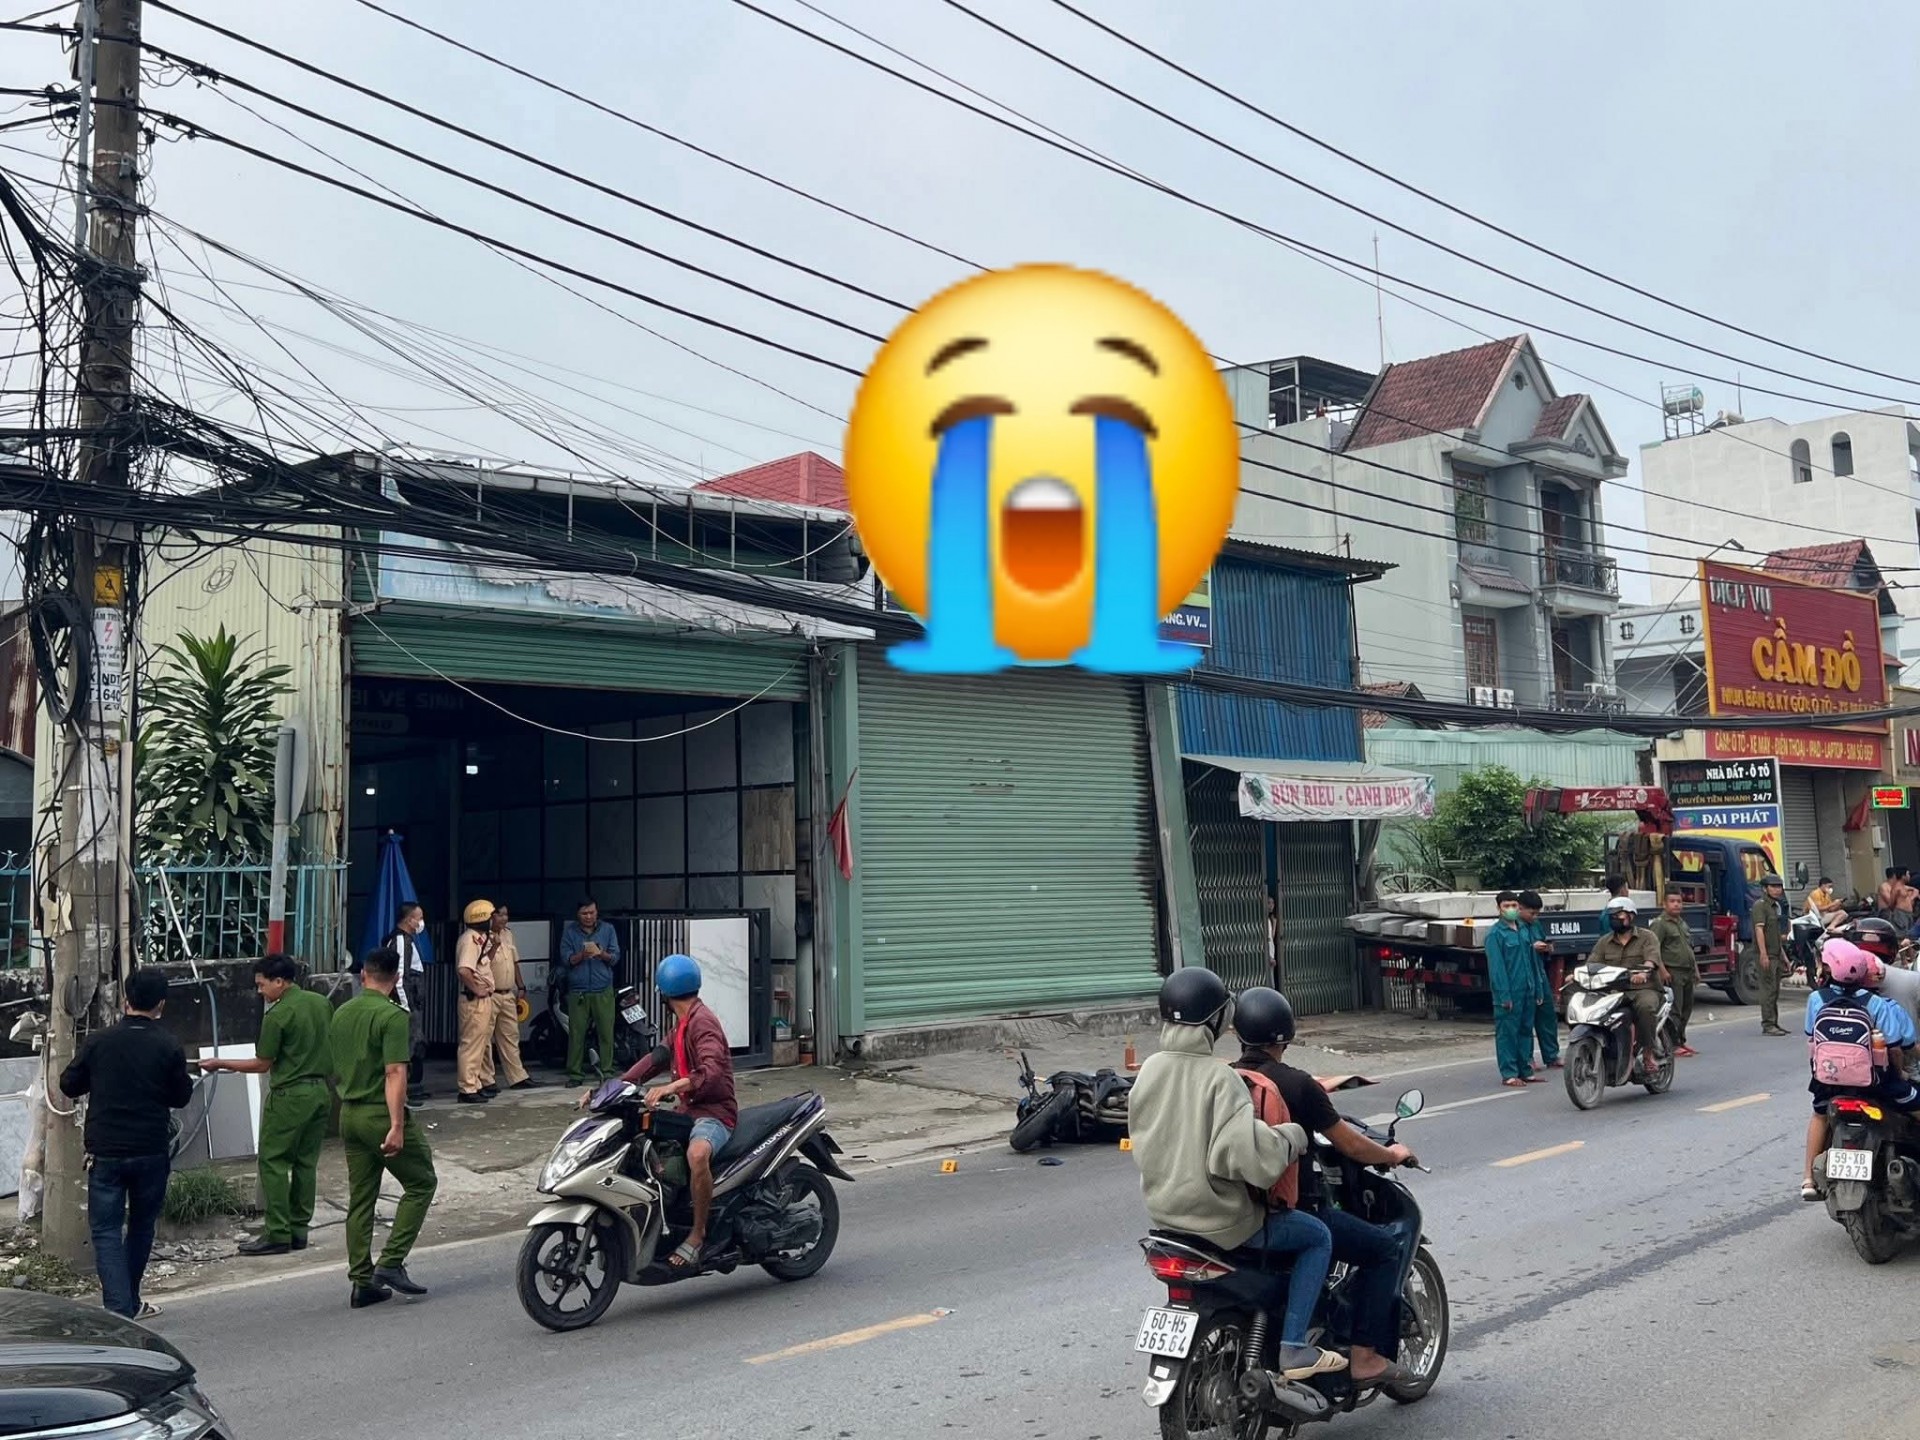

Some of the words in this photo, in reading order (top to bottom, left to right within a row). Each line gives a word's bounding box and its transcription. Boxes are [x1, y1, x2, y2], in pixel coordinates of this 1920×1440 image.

[1709, 576, 1746, 613] DỊCH
[1748, 584, 1771, 622] VỤ
[1752, 616, 1818, 687] CẦM
[1820, 629, 1861, 692] ĐỒ
[1706, 764, 1725, 780] NHÀ
[1726, 762, 1744, 779] ĐẤT
[1749, 763, 1757, 777] Ô
[1758, 762, 1770, 777] TÔ
[1346, 784, 1381, 806] CANH
[1753, 792, 1772, 801] 24/7
[1702, 813, 1727, 827] ĐẠI
[1731, 810, 1769, 824] PHÁT
[1151, 1312, 1189, 1334] 60-H5
[1139, 1331, 1187, 1354] 365.64
